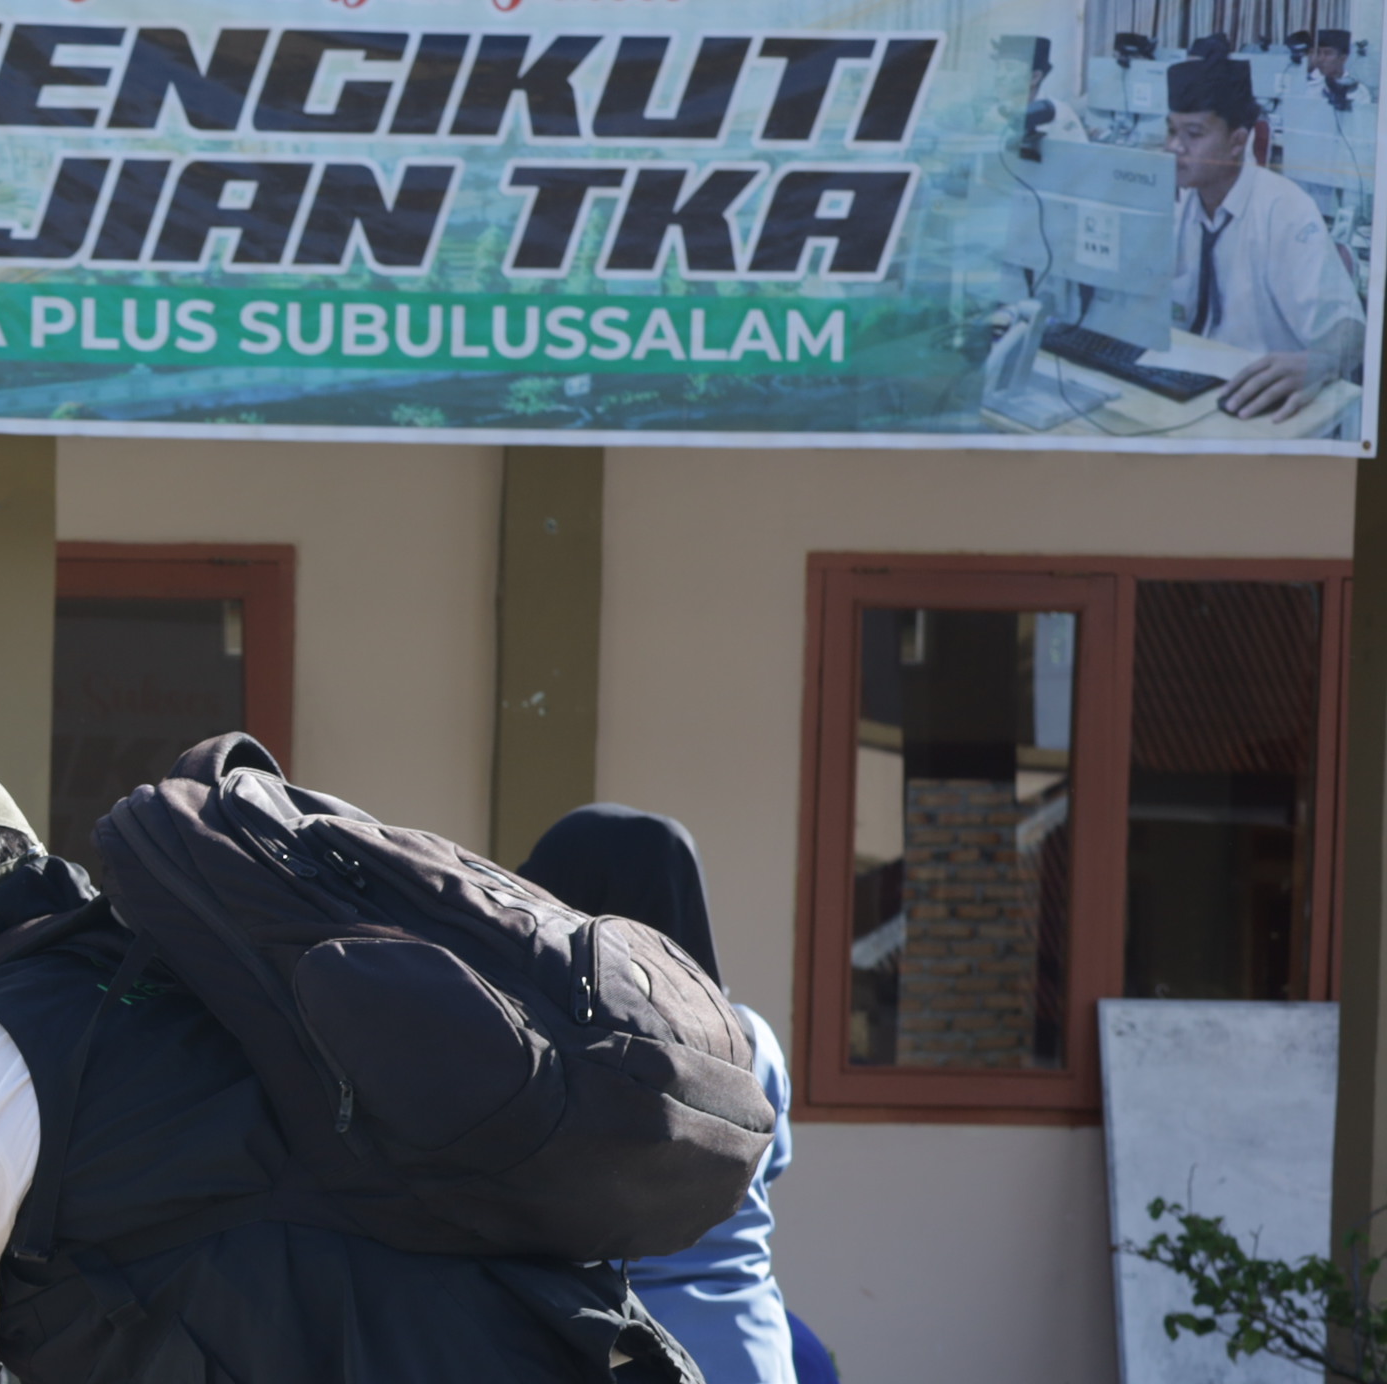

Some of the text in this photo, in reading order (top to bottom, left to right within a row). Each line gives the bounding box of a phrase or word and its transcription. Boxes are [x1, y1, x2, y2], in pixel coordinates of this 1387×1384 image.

[512, 166, 913, 276] TKA
[30, 297, 217, 353] PLUS
[237, 300, 847, 365] SUBULUSSALAM
